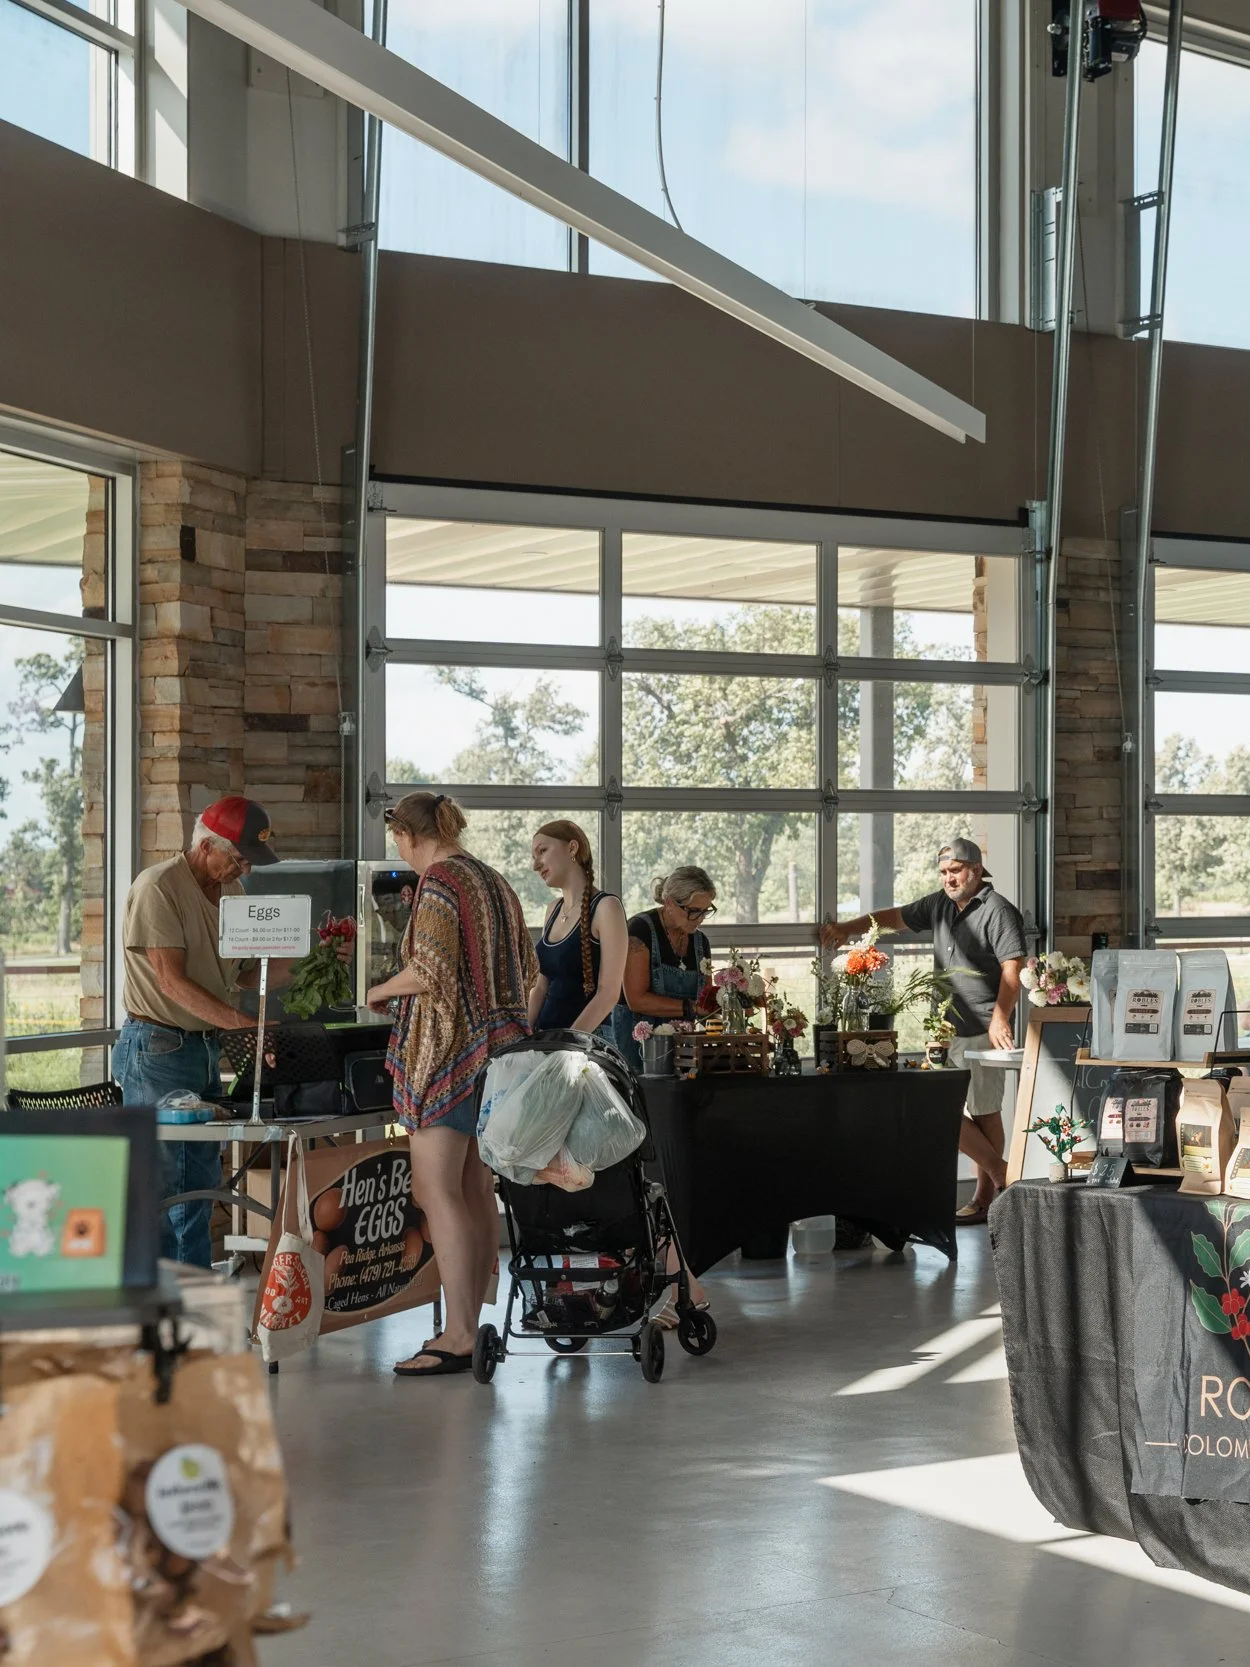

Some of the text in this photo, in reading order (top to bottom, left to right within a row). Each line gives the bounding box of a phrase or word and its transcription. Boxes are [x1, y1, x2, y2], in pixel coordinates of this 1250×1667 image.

[248, 904, 281, 921] Eggs
[338, 1157, 412, 1209] Hen's Be
[354, 1197, 407, 1245] EGGS
[339, 1251, 355, 1266] Pea
[378, 1240, 406, 1257] Arkansas
[328, 1271, 358, 1290] Phone:
[359, 1263, 382, 1285] (479)
[350, 1291, 369, 1305] Hens
[376, 1282, 387, 1298] All
